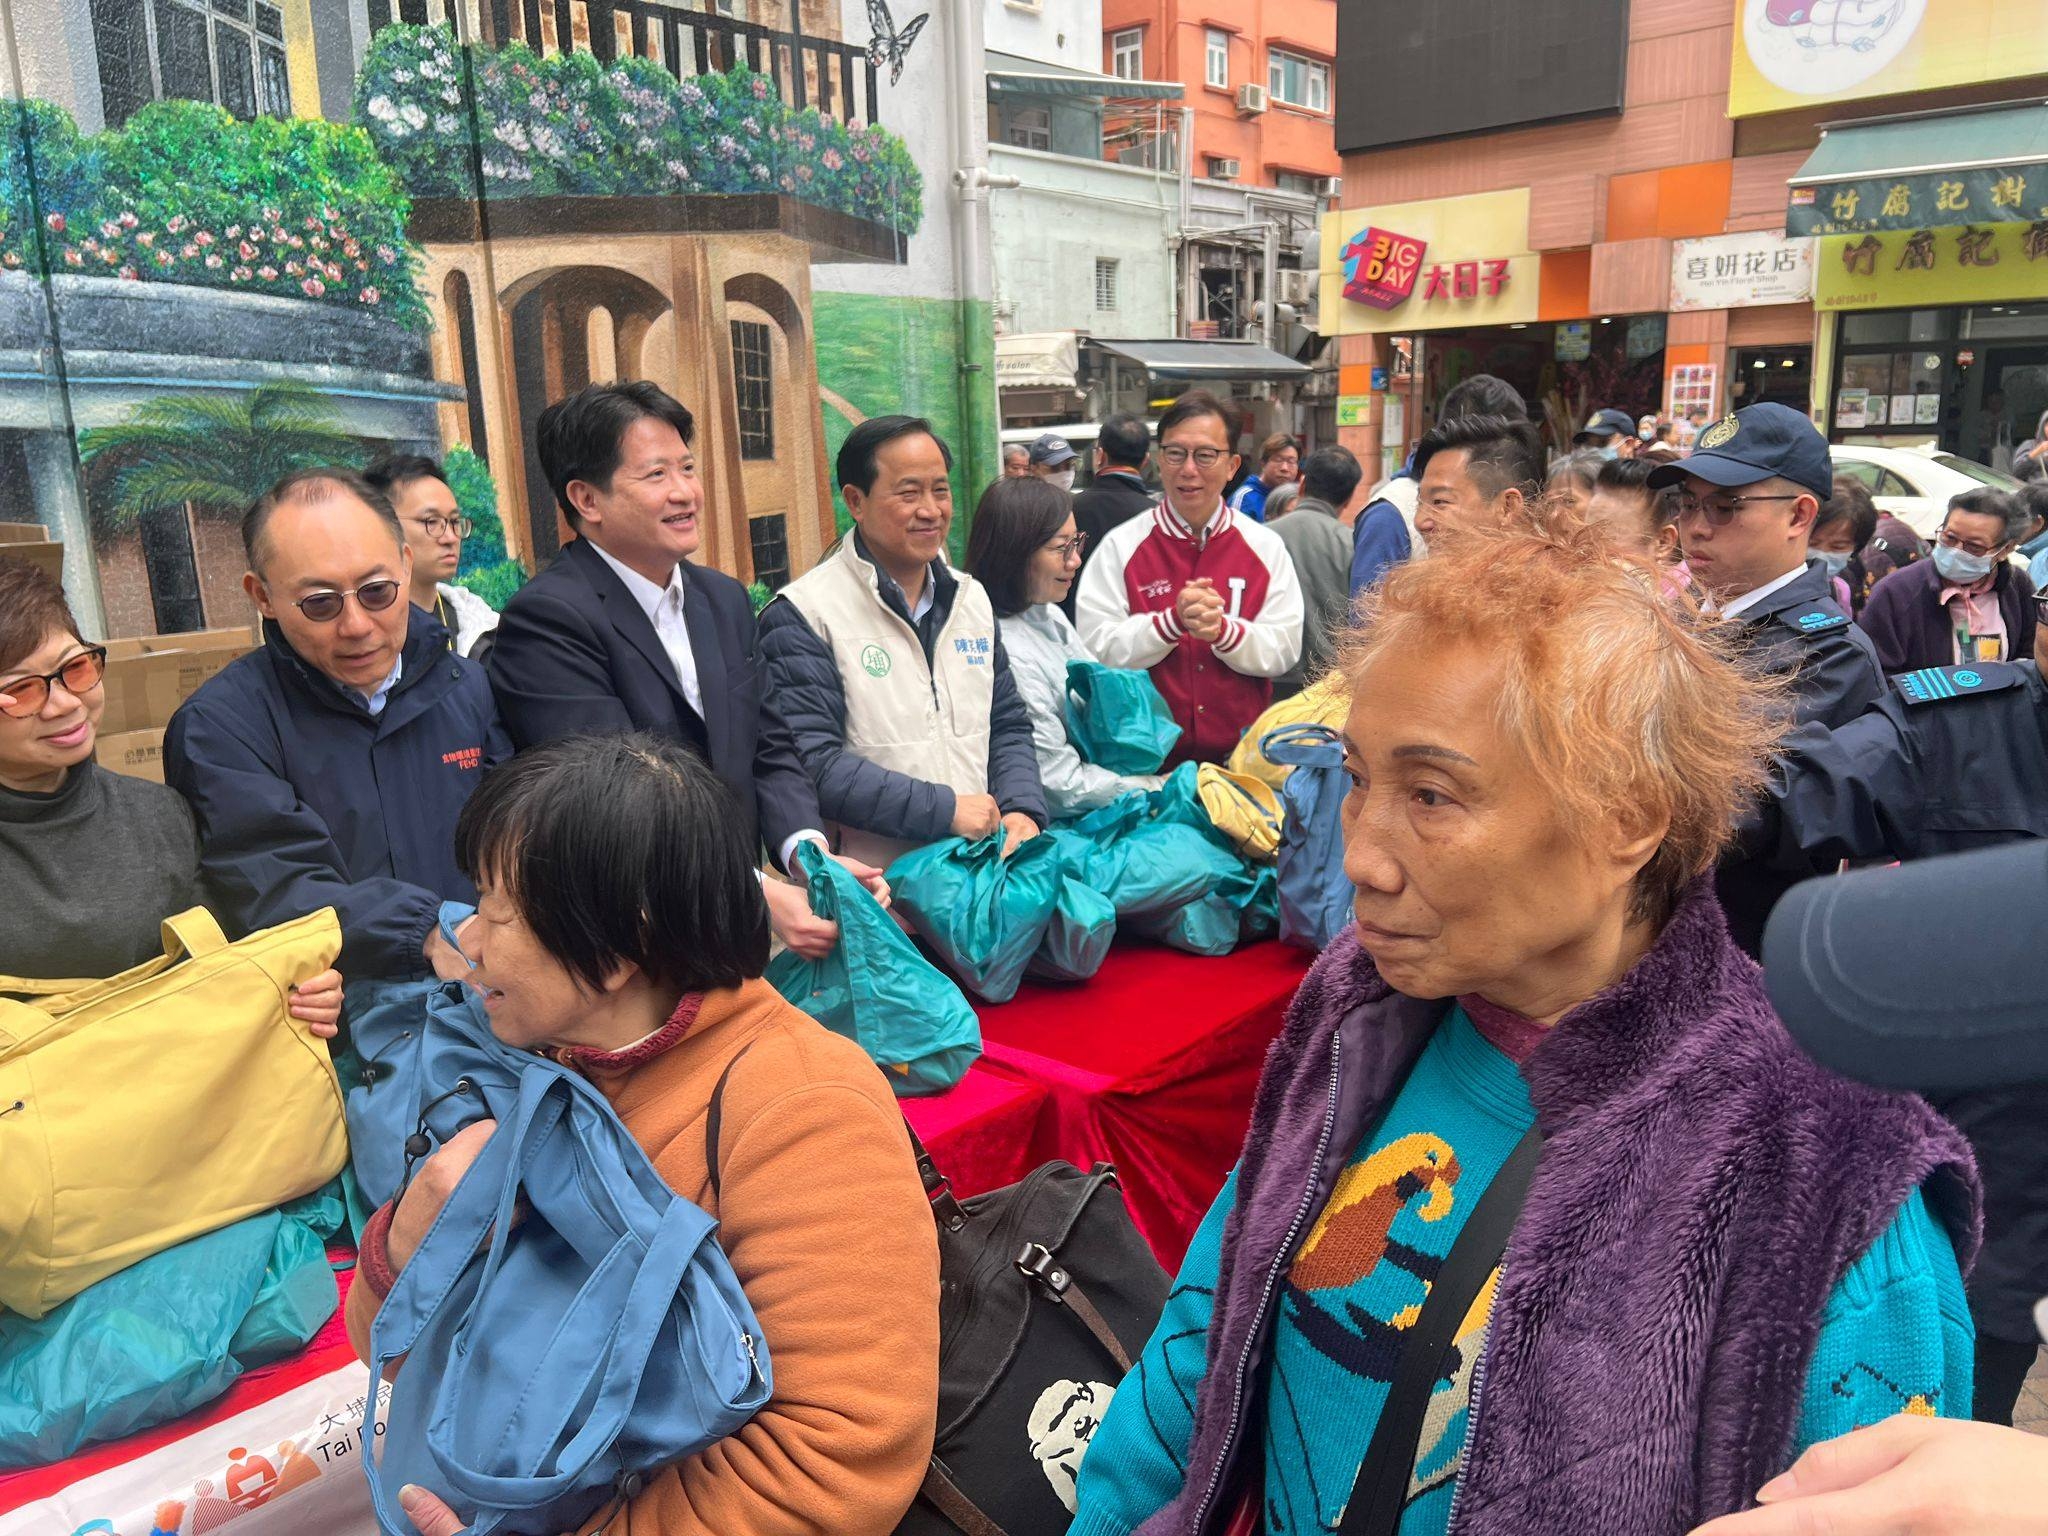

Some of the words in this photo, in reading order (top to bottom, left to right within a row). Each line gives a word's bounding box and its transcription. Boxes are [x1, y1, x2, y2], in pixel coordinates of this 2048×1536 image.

[1372, 235, 1418, 268] BIG
[1687, 248, 1798, 280] 喜妍花店
[1366, 259, 1412, 289] DAY
[1423, 259, 1511, 300] 大日子
[316, 1433, 353, 1462] Tai
